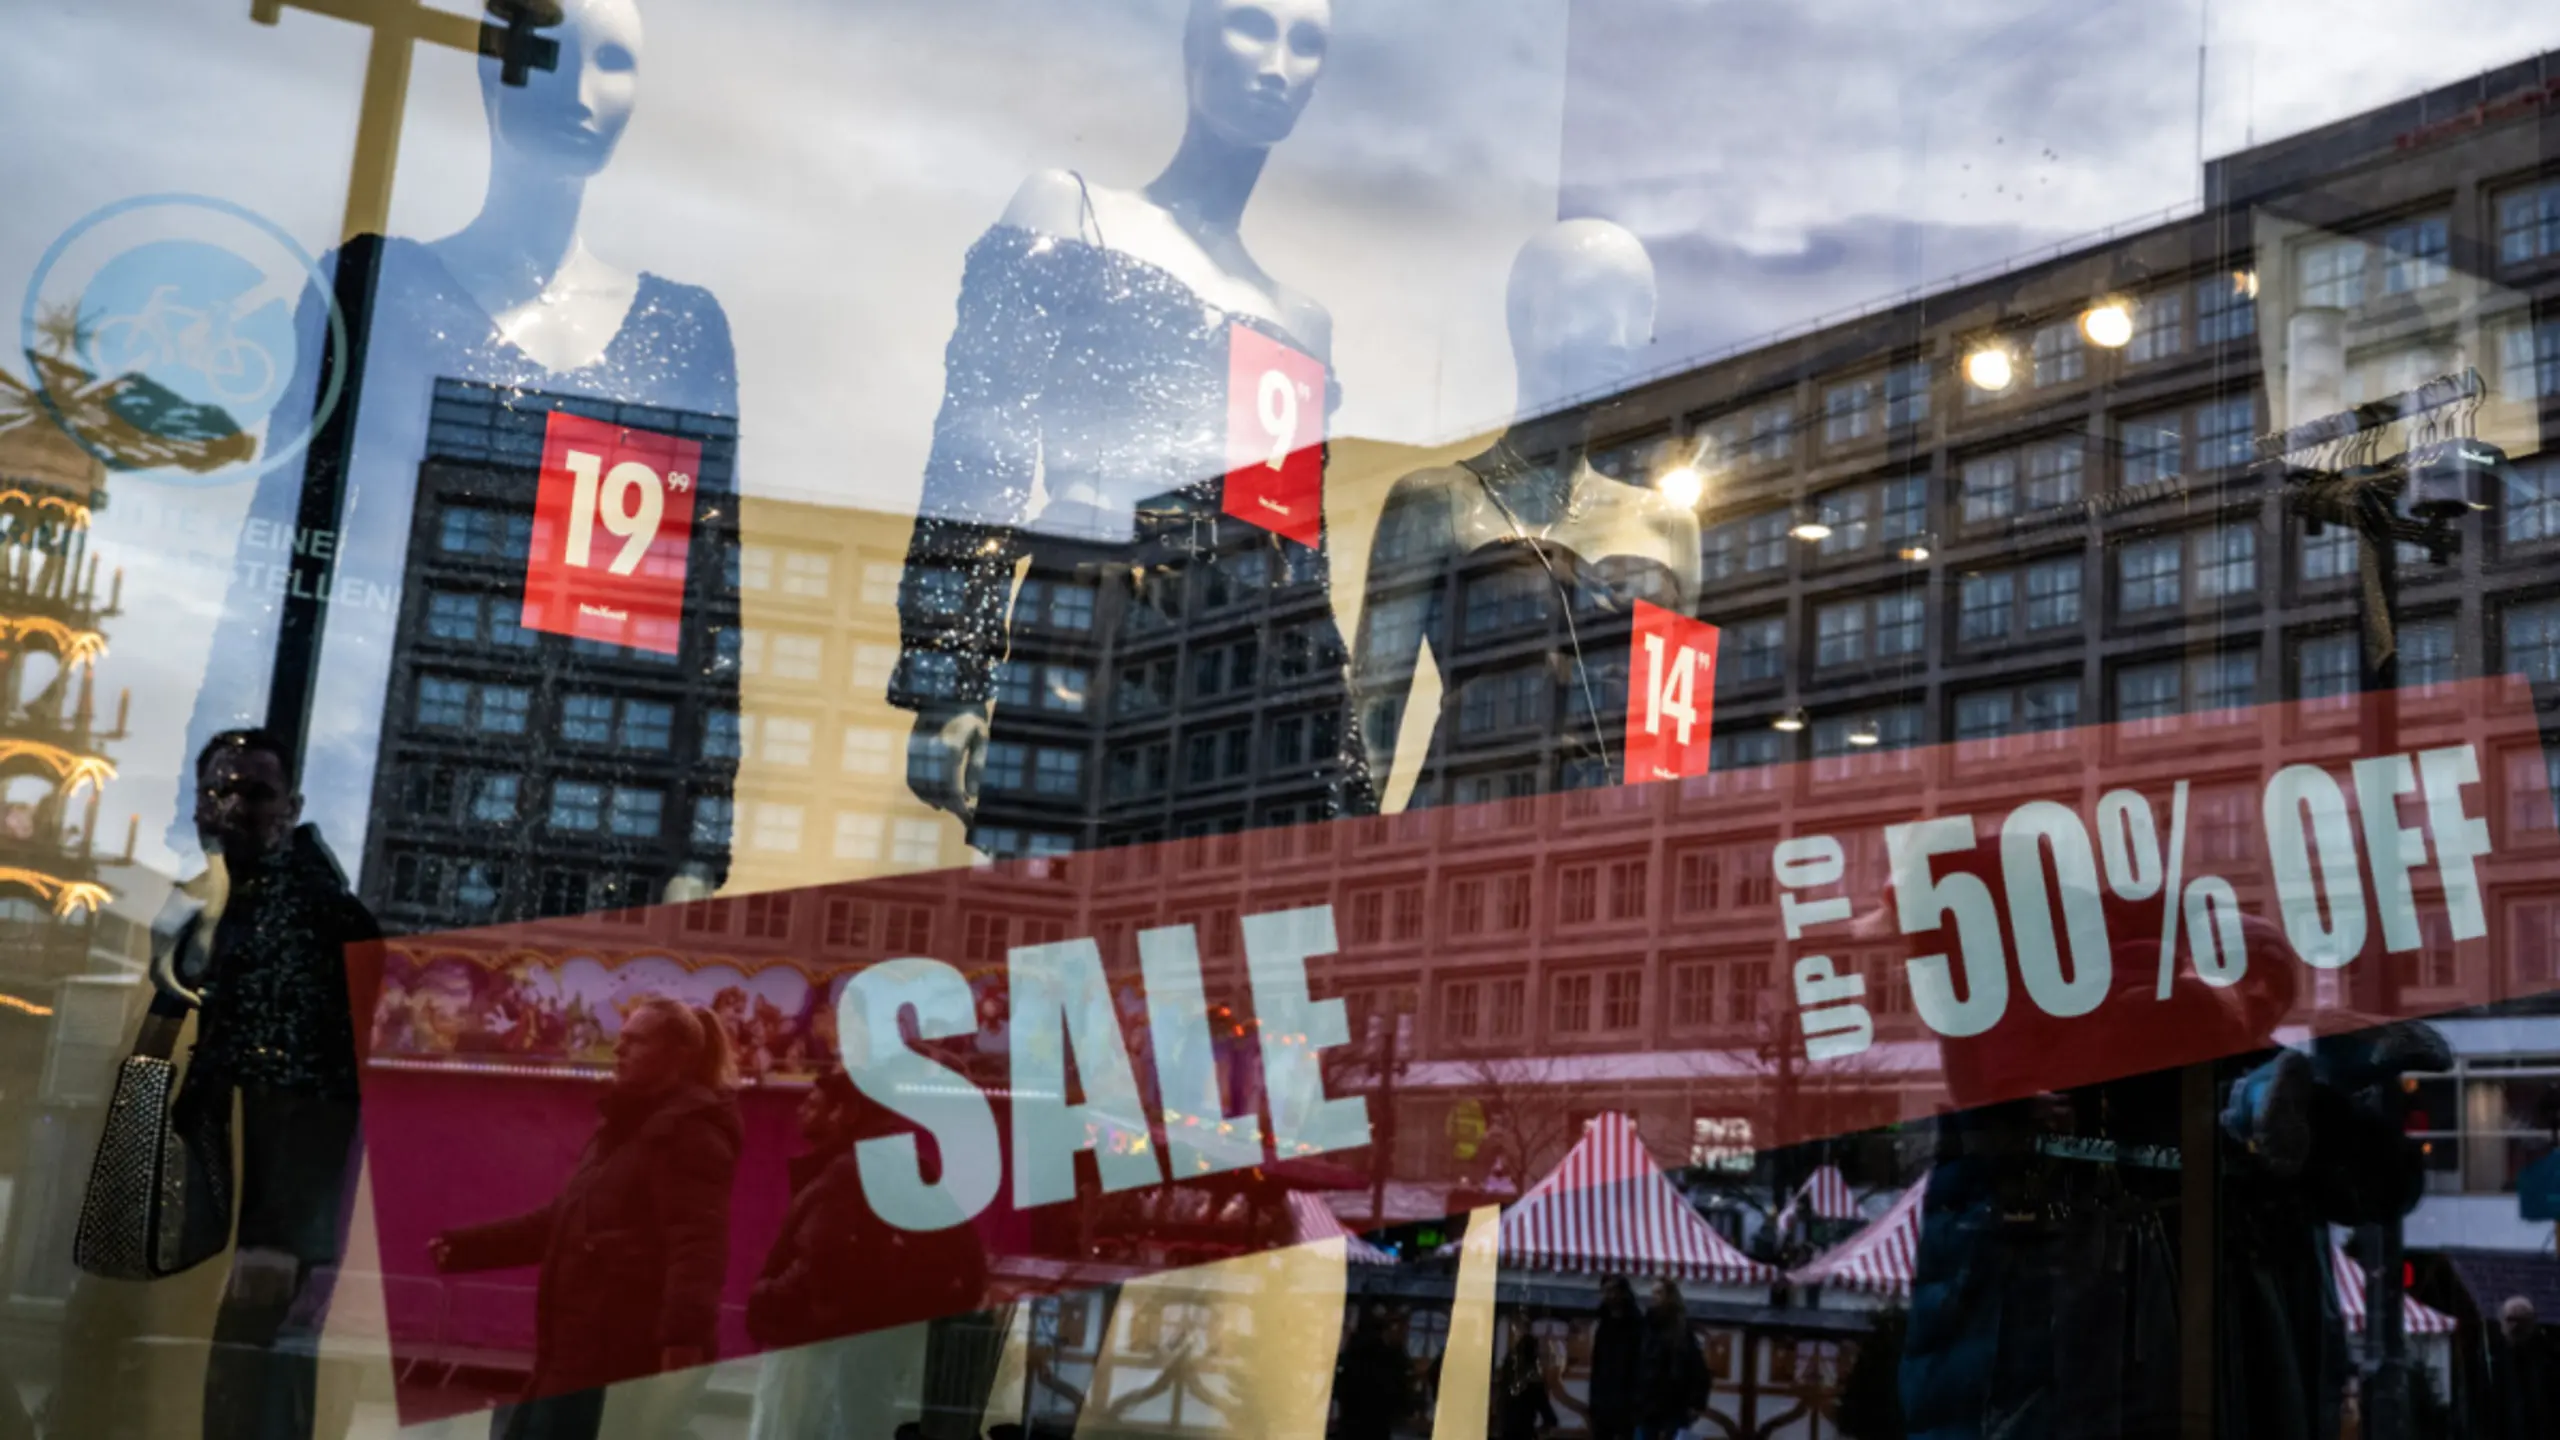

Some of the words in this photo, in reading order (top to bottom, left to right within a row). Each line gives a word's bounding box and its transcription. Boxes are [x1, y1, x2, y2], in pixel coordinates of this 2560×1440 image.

[1258, 369, 1297, 472] 9
[220, 513, 335, 560] EINE
[565, 449, 664, 576] 19
[668, 471, 689, 492] 99
[1644, 631, 1697, 746] 14
[1773, 835, 1852, 939] TO
[1885, 780, 2249, 1037] 50%
[2263, 744, 2492, 969] OFF
[1794, 954, 1874, 1061] UP
[837, 904, 1371, 1232] SALE
